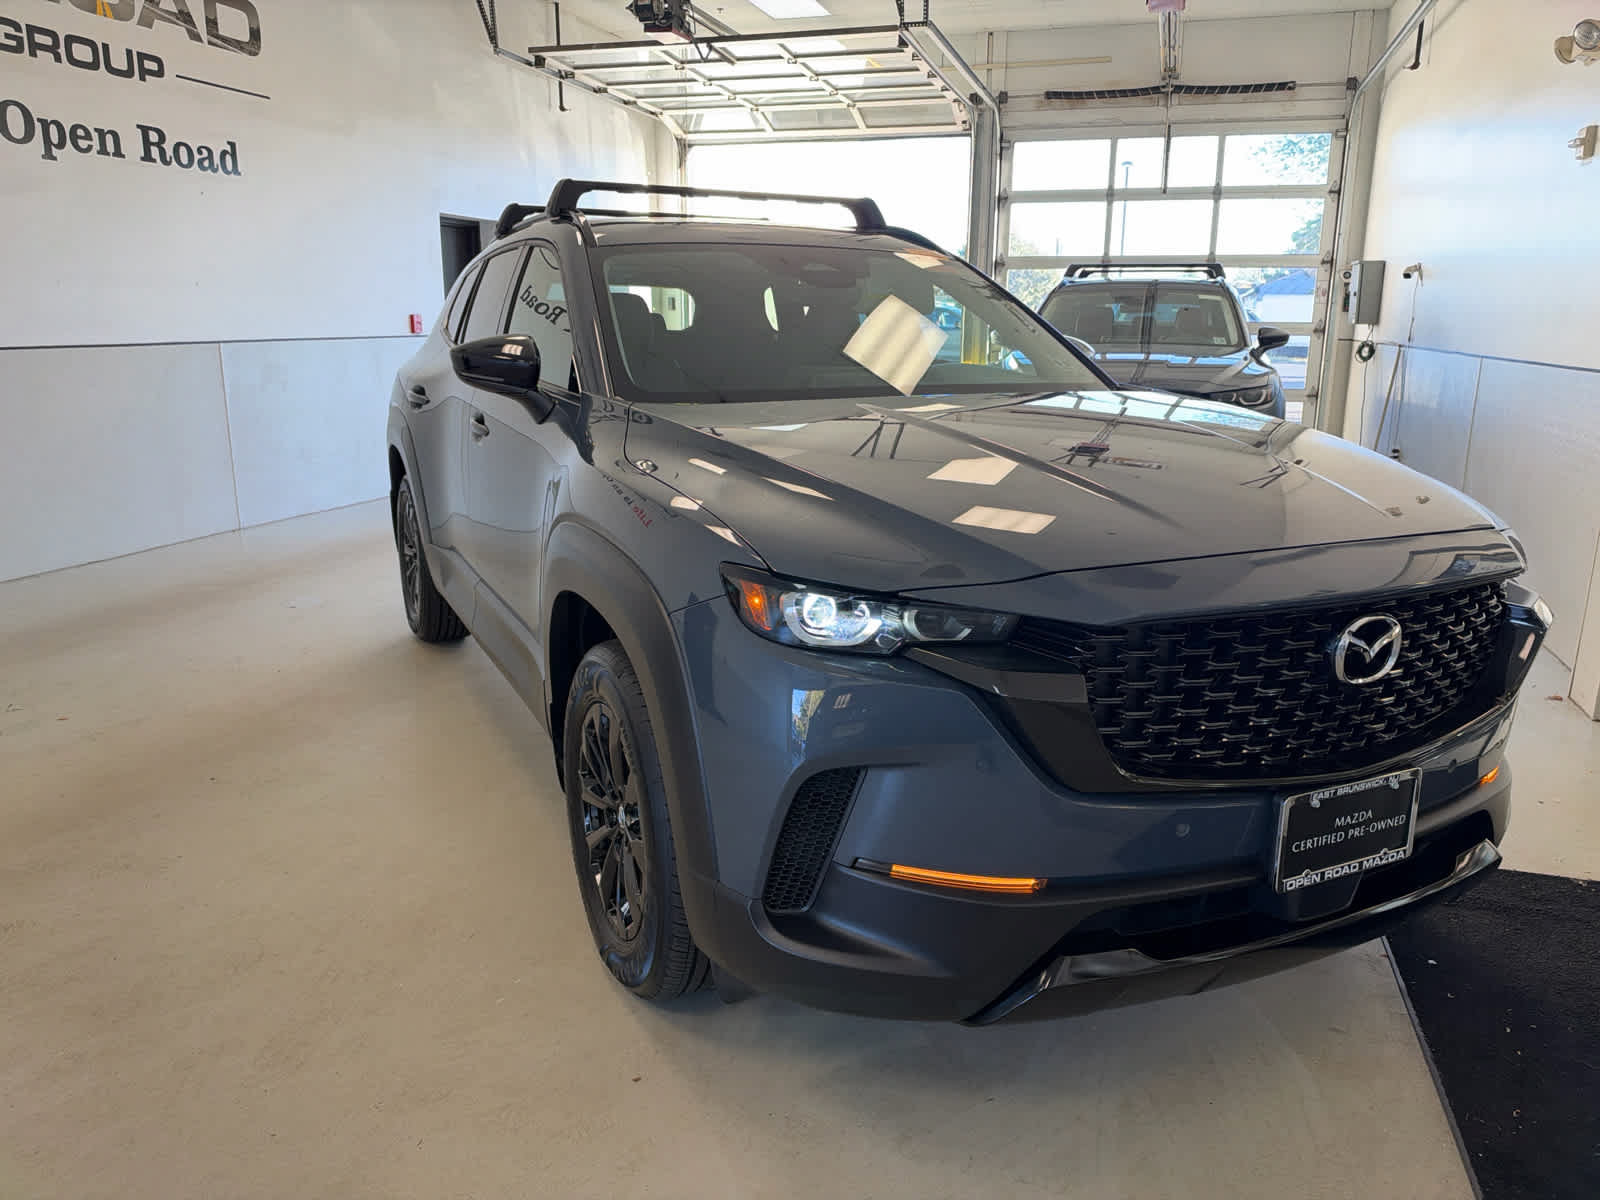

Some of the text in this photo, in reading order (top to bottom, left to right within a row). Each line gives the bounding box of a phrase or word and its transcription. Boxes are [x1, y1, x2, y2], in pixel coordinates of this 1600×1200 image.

[48, 0, 261, 57] AD
[0, 16, 165, 82] GROUP
[0, 100, 242, 176] Open Road
[1312, 789, 1336, 802] EAST
[1292, 814, 1407, 853] CERTIFIED PRE-OWNED
[1334, 808, 1373, 828] MAZDA
[1286, 851, 1405, 891] OPEN ROAD MAZDA
